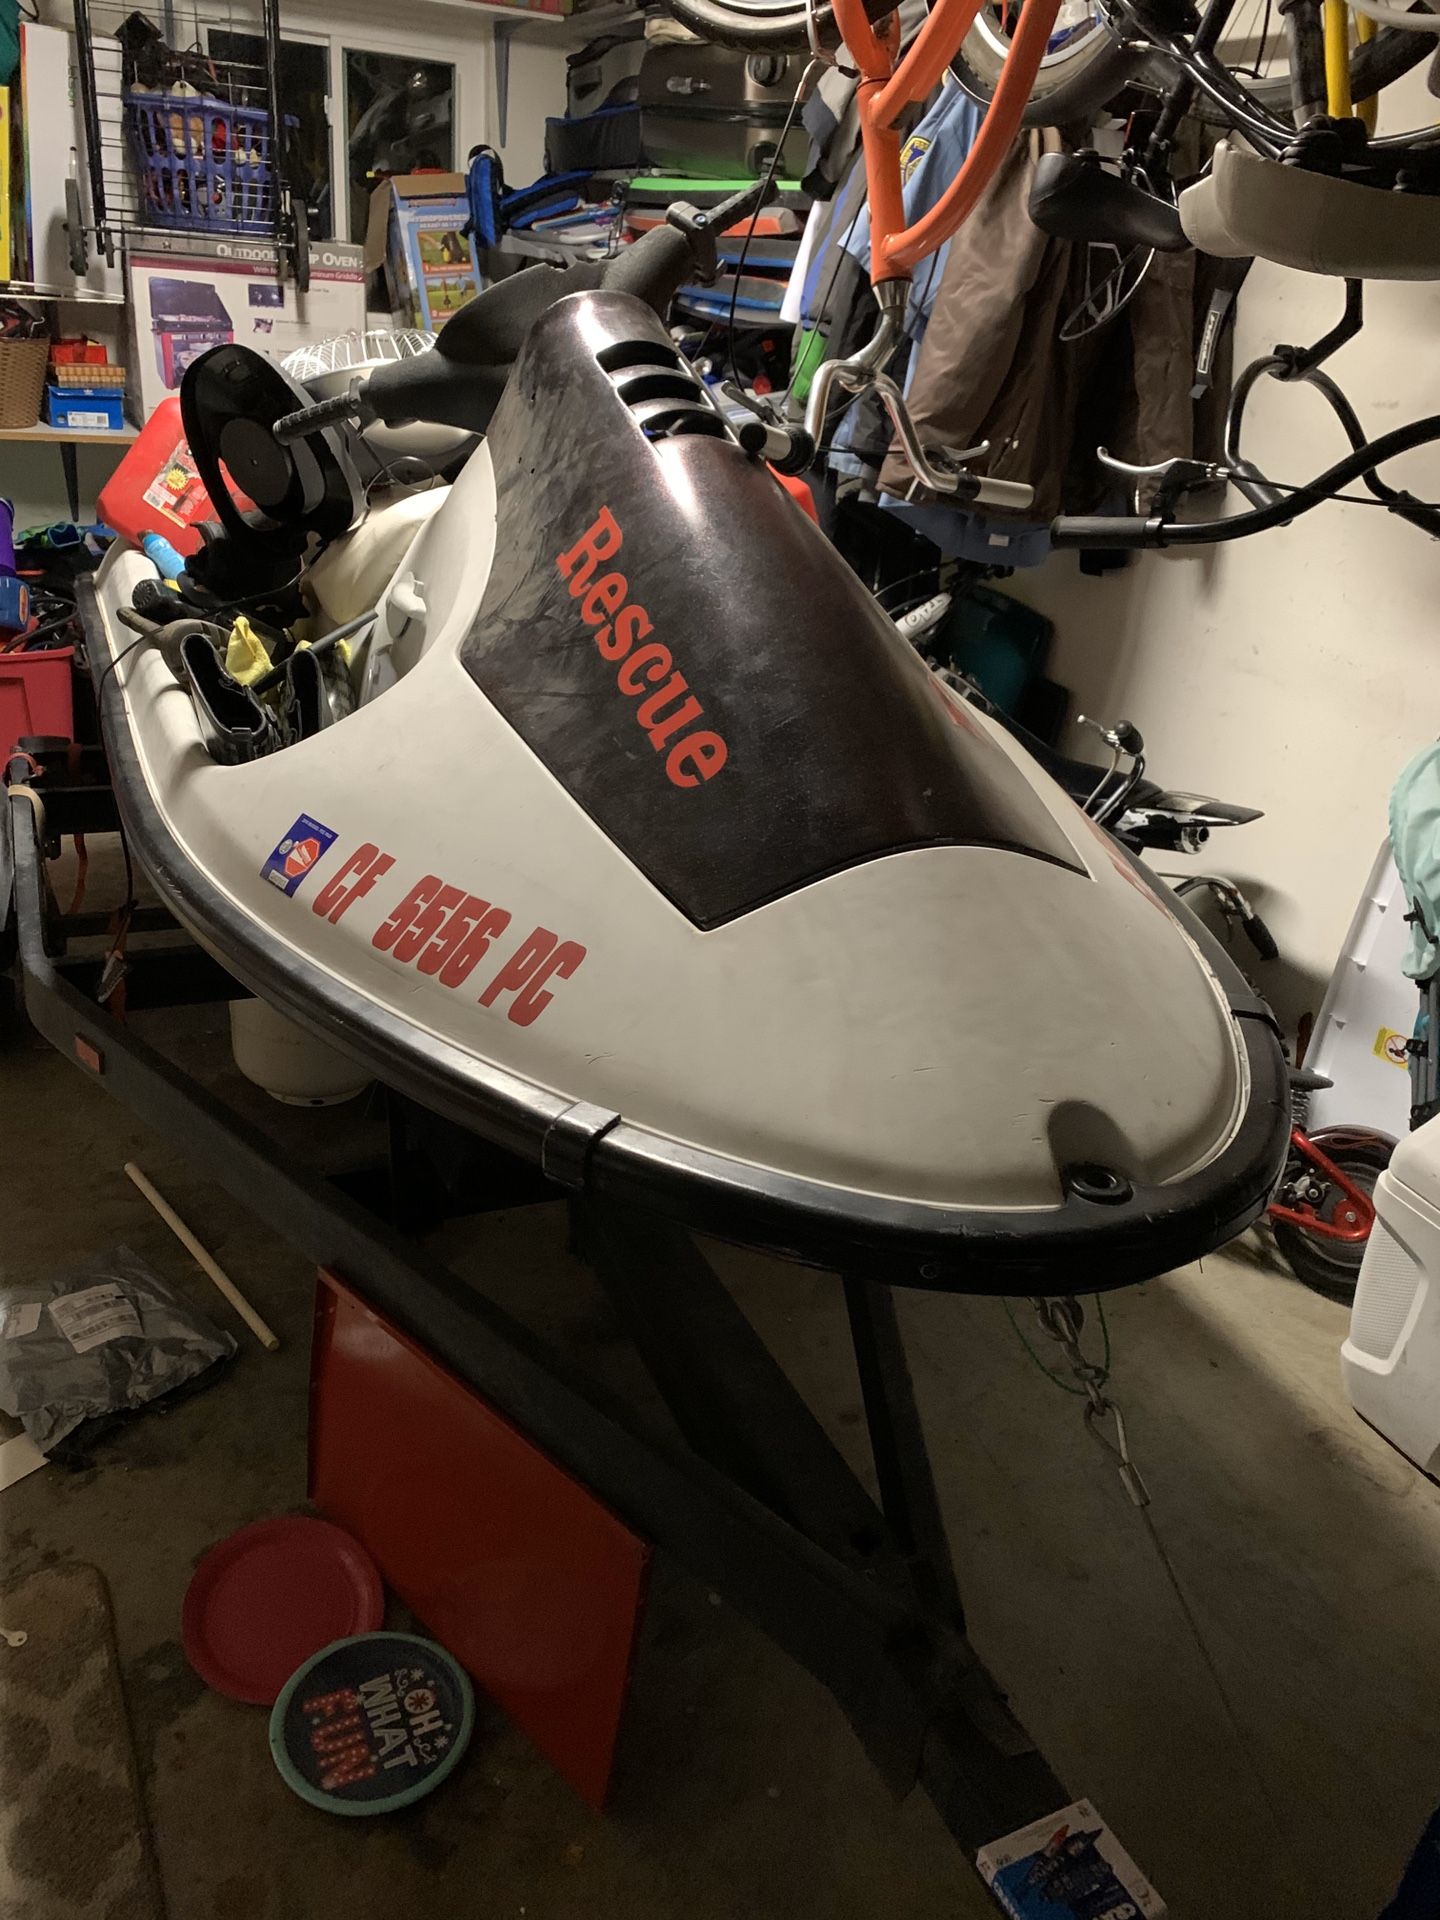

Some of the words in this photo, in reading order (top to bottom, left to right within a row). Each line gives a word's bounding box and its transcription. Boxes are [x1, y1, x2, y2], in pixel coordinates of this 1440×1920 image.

[322, 252, 358, 268] OVEN
[556, 505, 728, 788] Rescue
[312, 843, 396, 925] CF
[478, 927, 587, 1027] PC
[302, 1688, 378, 1790] FUN
[359, 1673, 418, 1770] WHAT
[403, 1688, 444, 1736] OH
